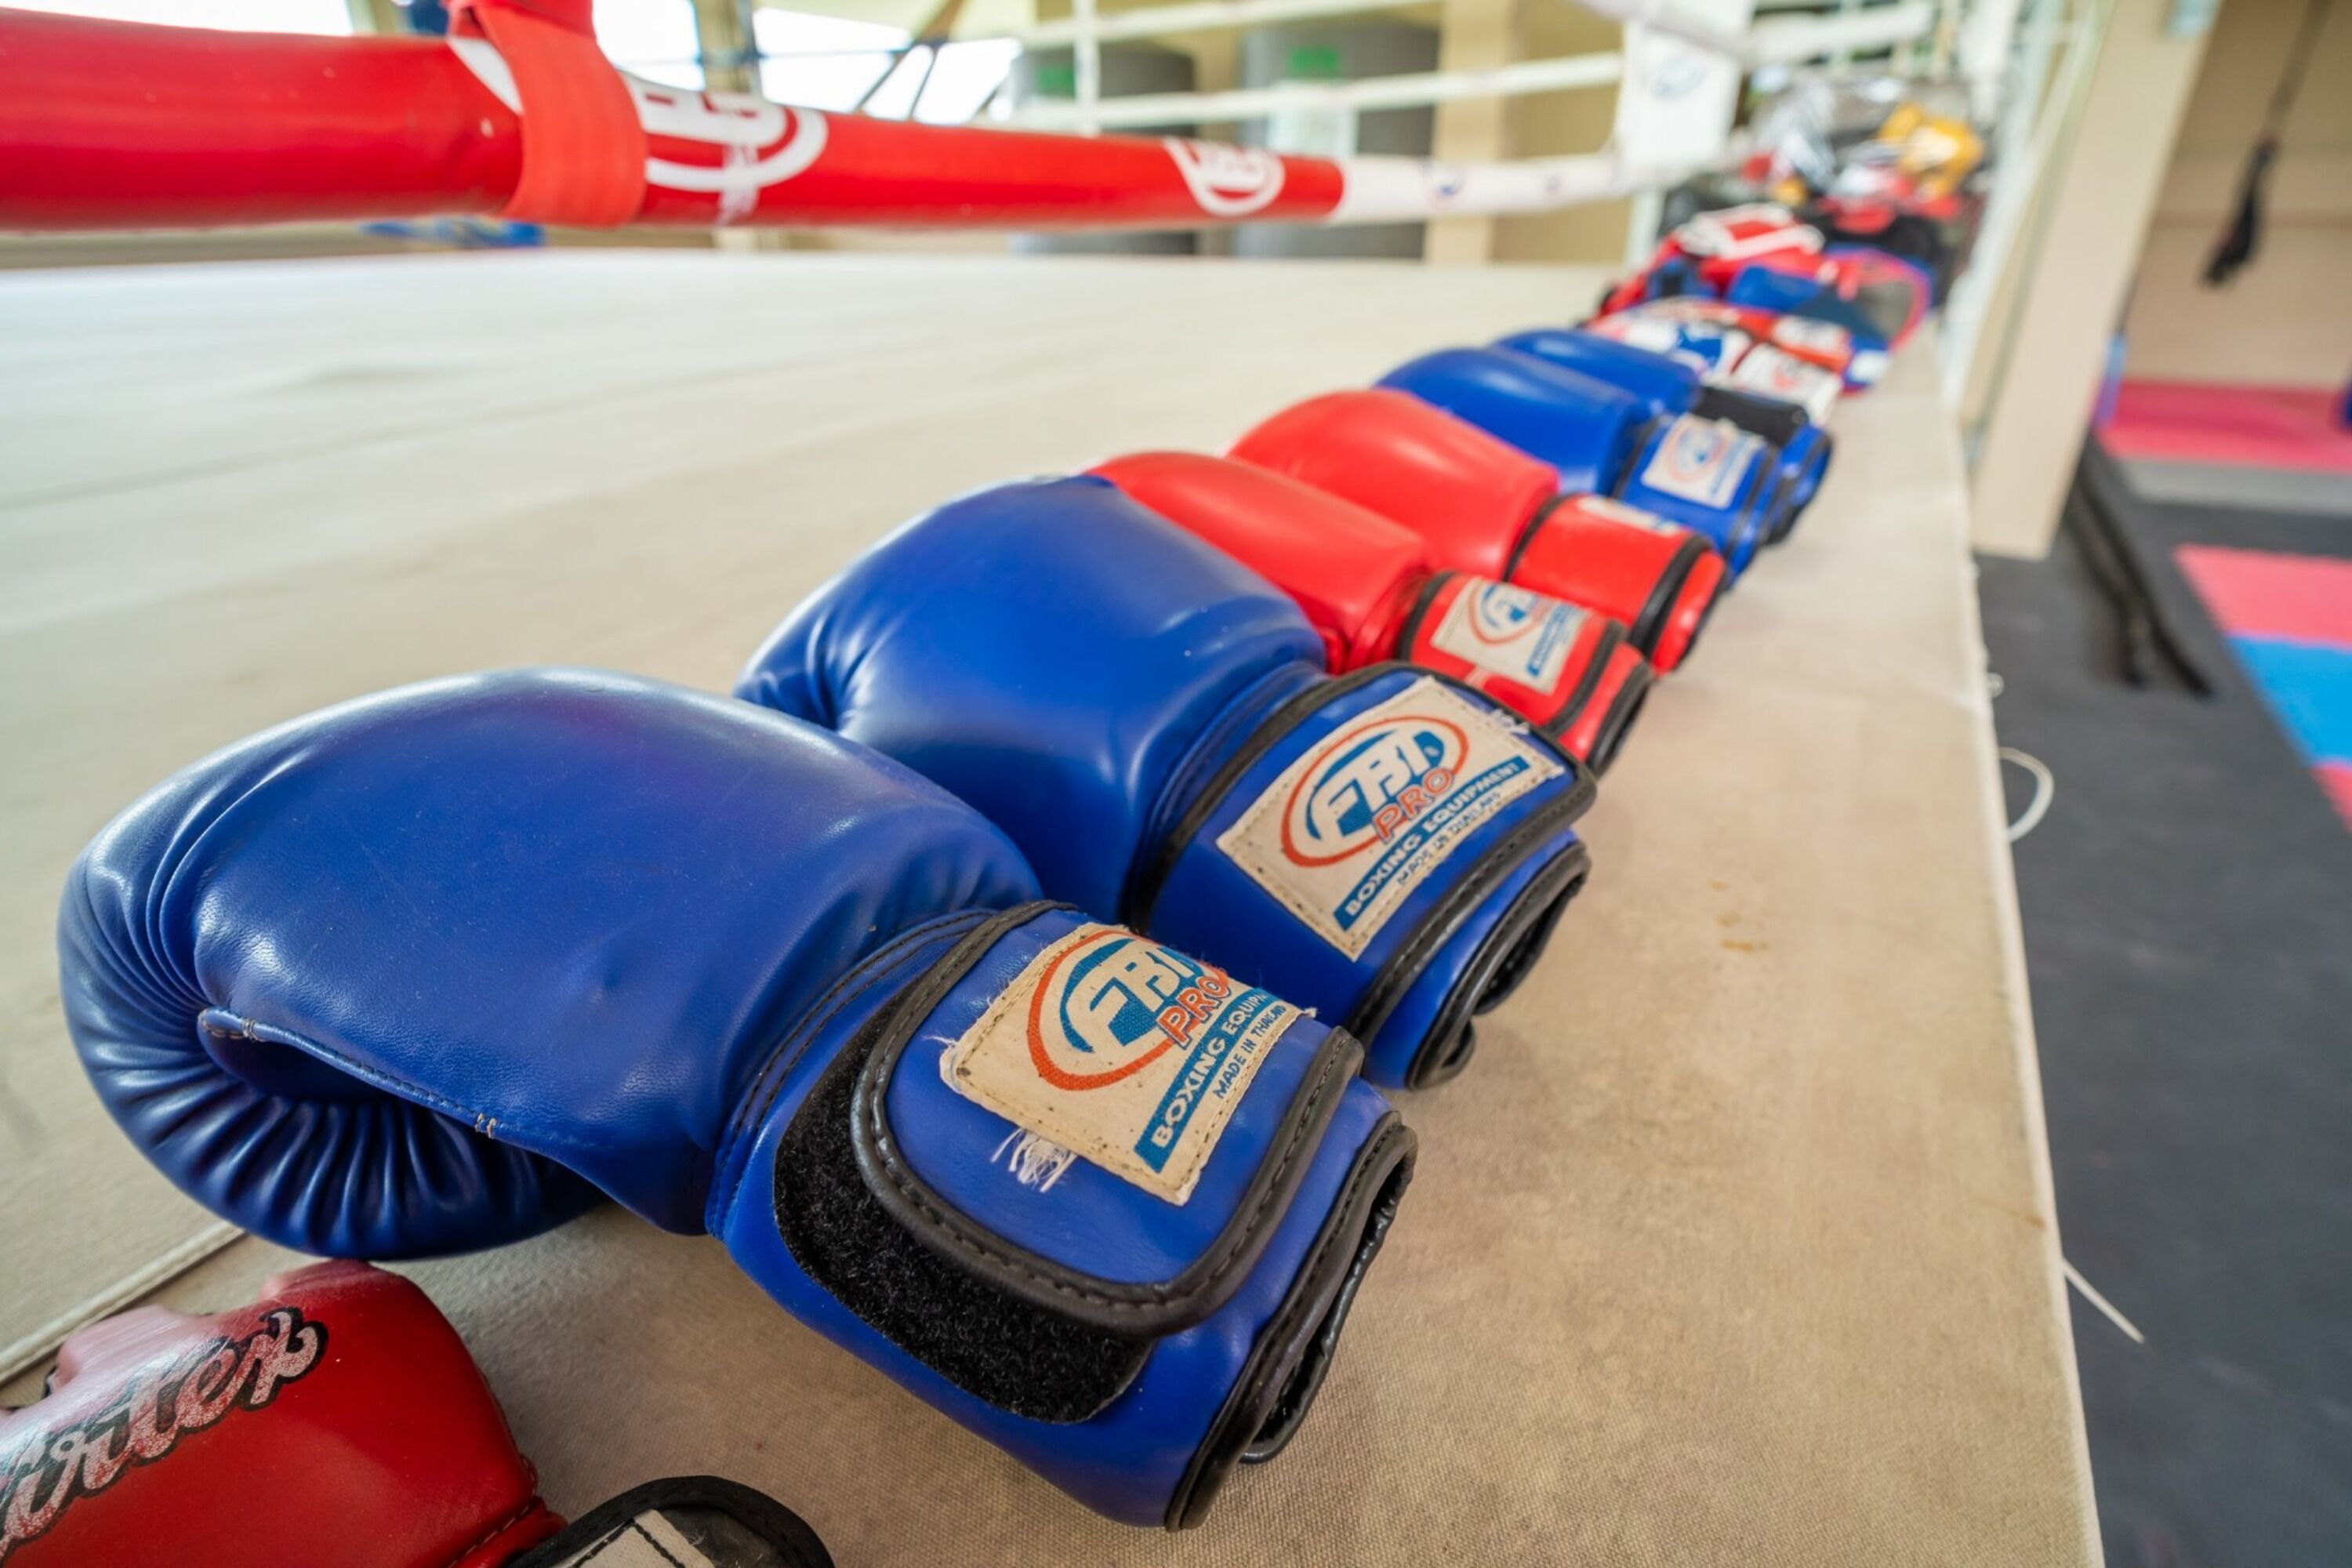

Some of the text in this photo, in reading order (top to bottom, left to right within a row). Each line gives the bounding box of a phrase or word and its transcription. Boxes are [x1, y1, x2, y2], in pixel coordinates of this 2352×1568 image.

[1345, 762, 1519, 916] BOXING EQUIPMENT
[1372, 768, 1454, 844] PRO
[1156, 974, 1232, 1051] PRO
[1151, 1036, 1226, 1149] BOXING
[1213, 1053, 1247, 1099] MADE
[1240, 1038, 1257, 1054] IN
